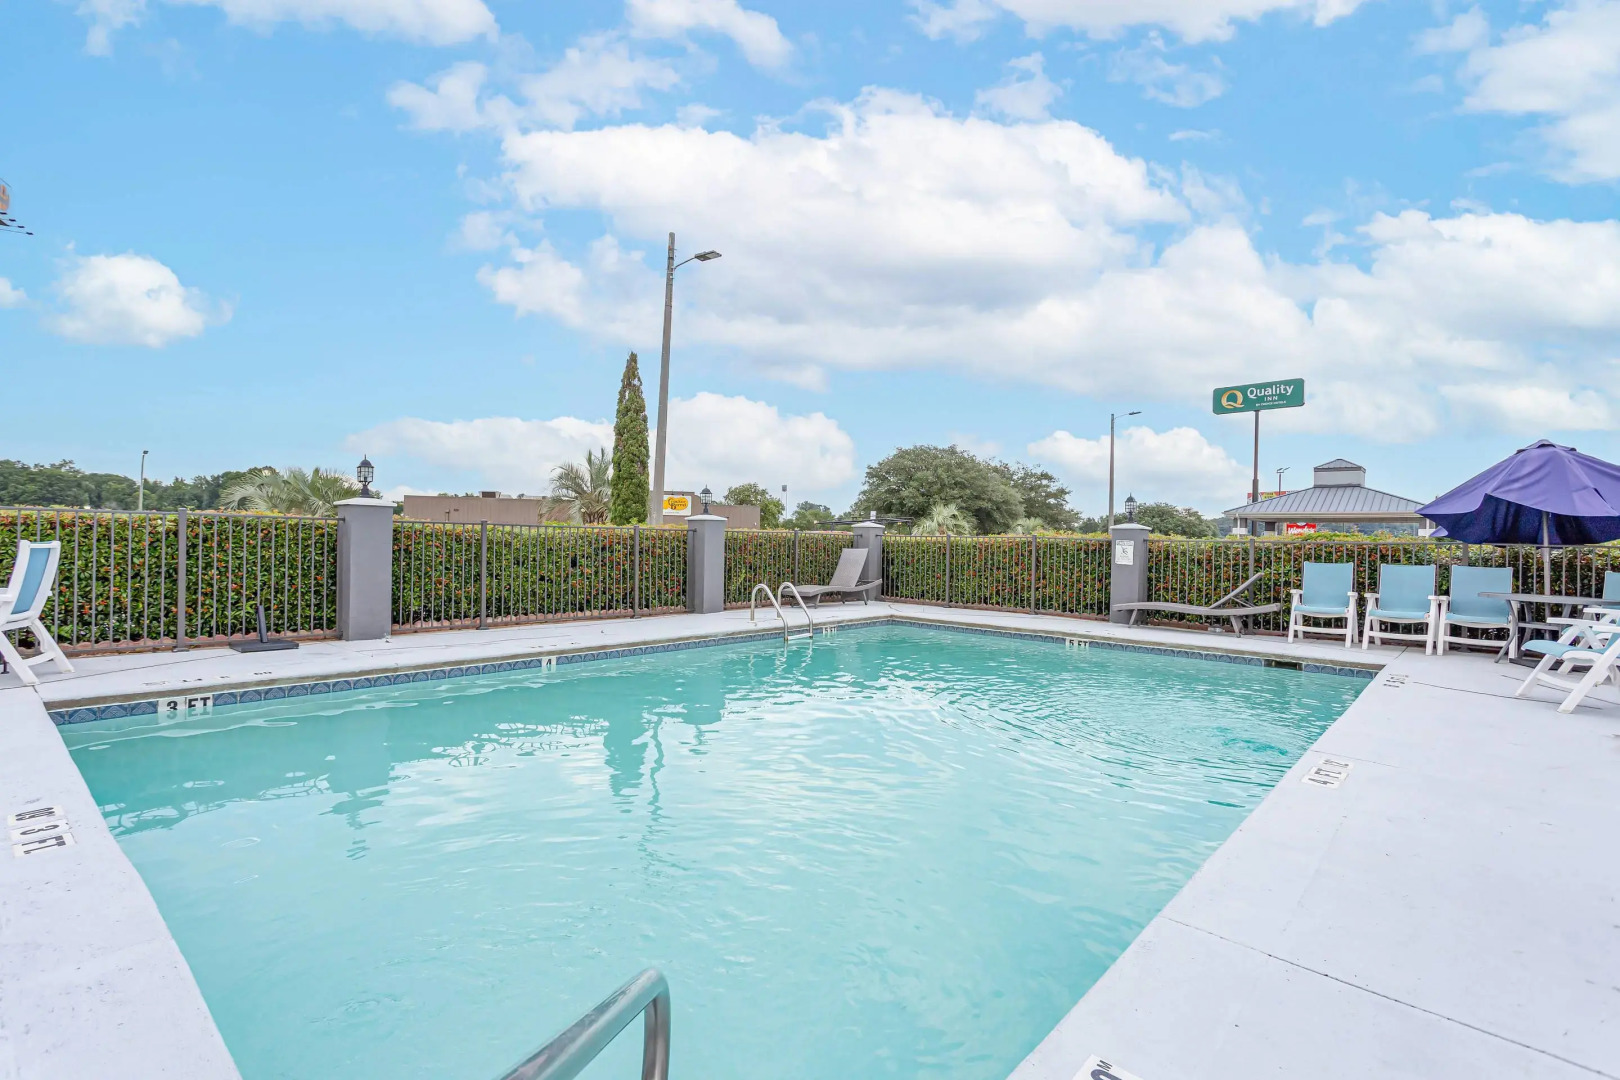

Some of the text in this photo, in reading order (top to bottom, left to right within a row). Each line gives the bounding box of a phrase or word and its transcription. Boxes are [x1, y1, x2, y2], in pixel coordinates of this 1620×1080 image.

[1247, 384, 1294, 399] Quality
[20, 824, 60, 835] 3
[21, 835, 66, 855] FT
